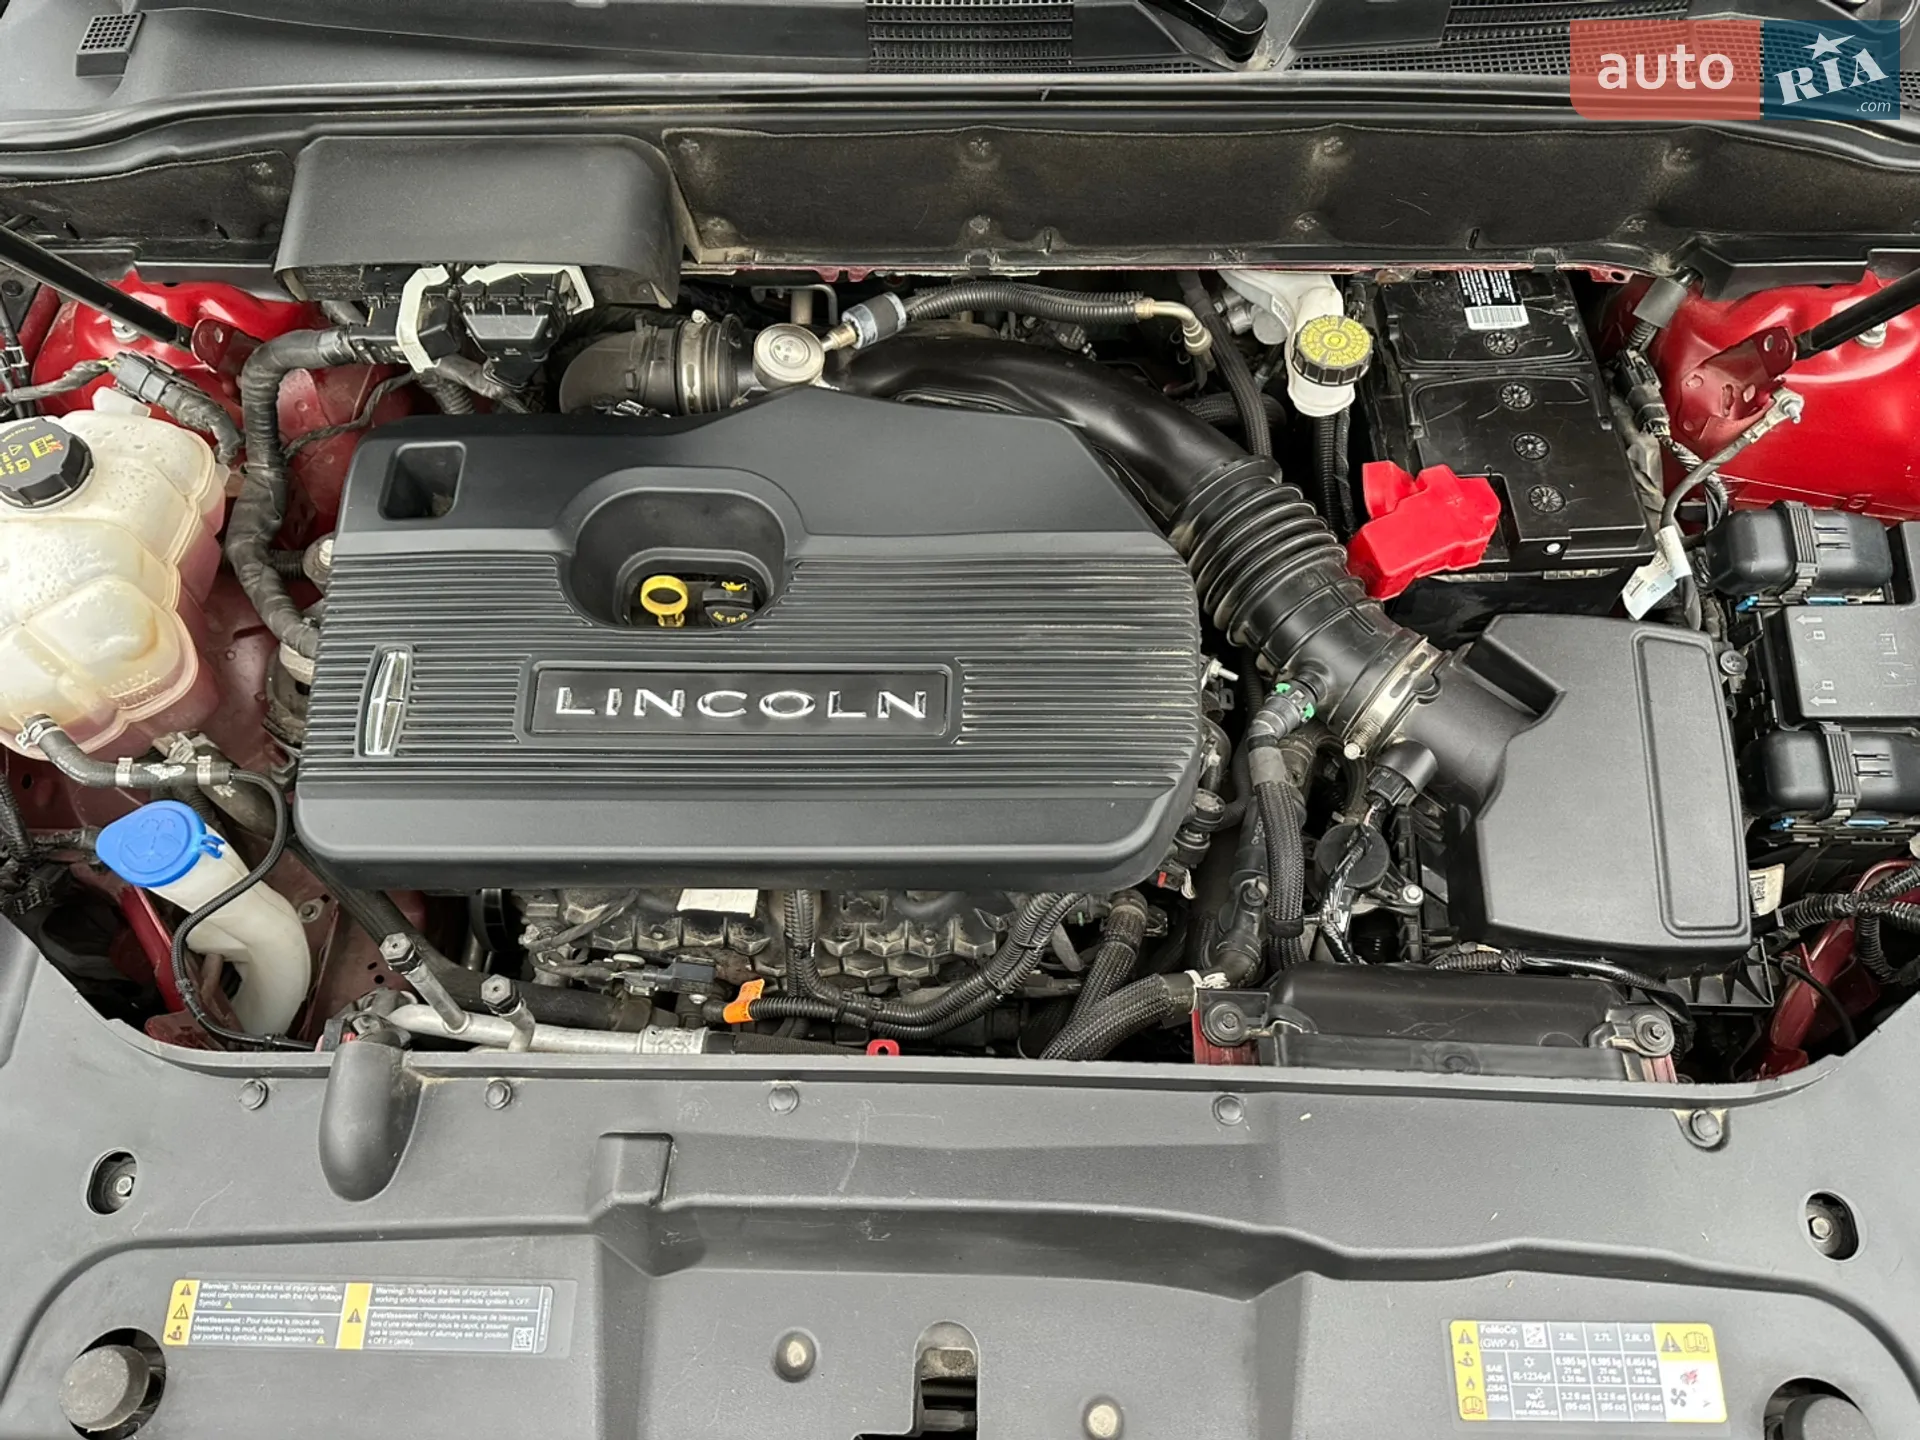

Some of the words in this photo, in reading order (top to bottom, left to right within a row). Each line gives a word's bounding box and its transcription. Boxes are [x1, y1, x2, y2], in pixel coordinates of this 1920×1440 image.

[556, 687, 927, 719] LINCOLN
[202, 1282, 230, 1291] Warning:
[376, 1287, 404, 1296] Warning:
[217, 1292, 253, 1301] components
[375, 1296, 398, 1305] working
[1480, 1324, 1518, 1335] FoMoCo
